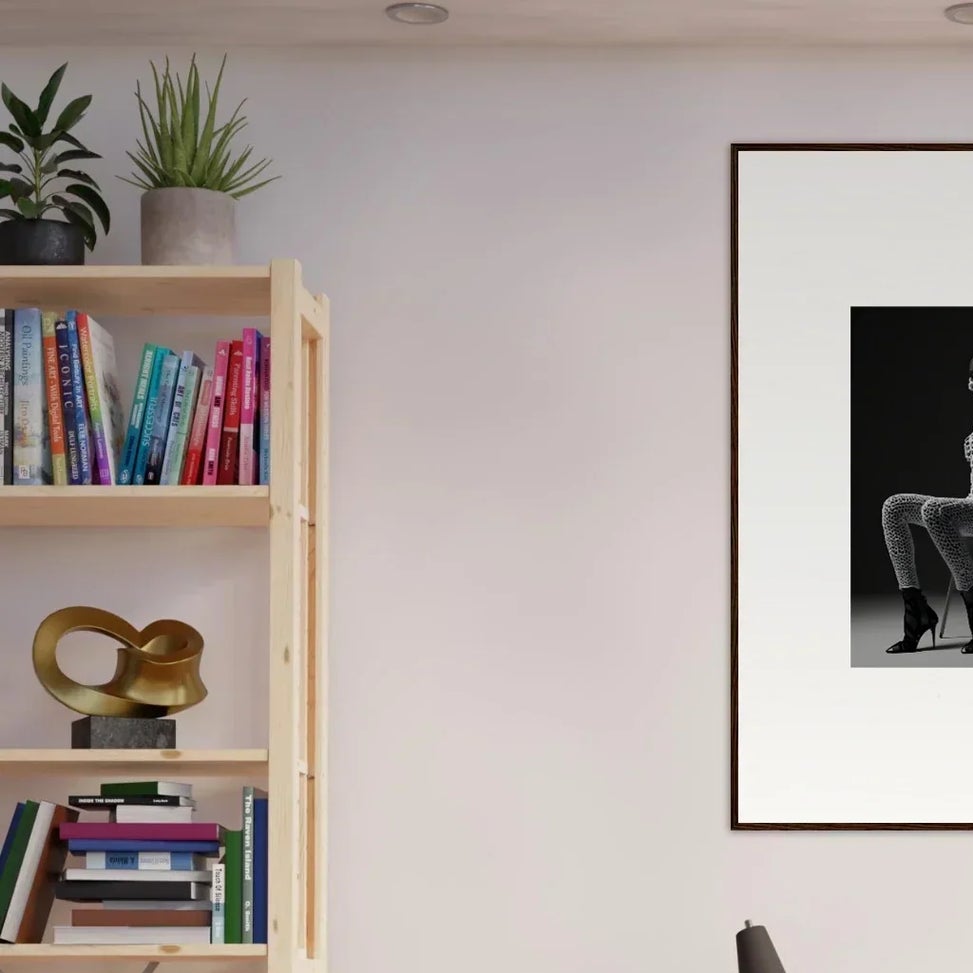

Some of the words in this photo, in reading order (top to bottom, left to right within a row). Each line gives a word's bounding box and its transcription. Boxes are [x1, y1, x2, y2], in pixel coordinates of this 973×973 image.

[22, 325, 32, 340] Oil
[19, 342, 32, 386] Paintings
[48, 365, 56, 379] ART
[80, 327, 92, 373] Watercolor
[87, 376, 98, 411] Portraits
[230, 363, 241, 397] Parenting
[49, 385, 58, 402] With
[49, 403, 60, 425] Digital
[229, 398, 240, 416] Skills
[53, 426, 62, 442] Tools
[215, 868, 224, 883] Touch
